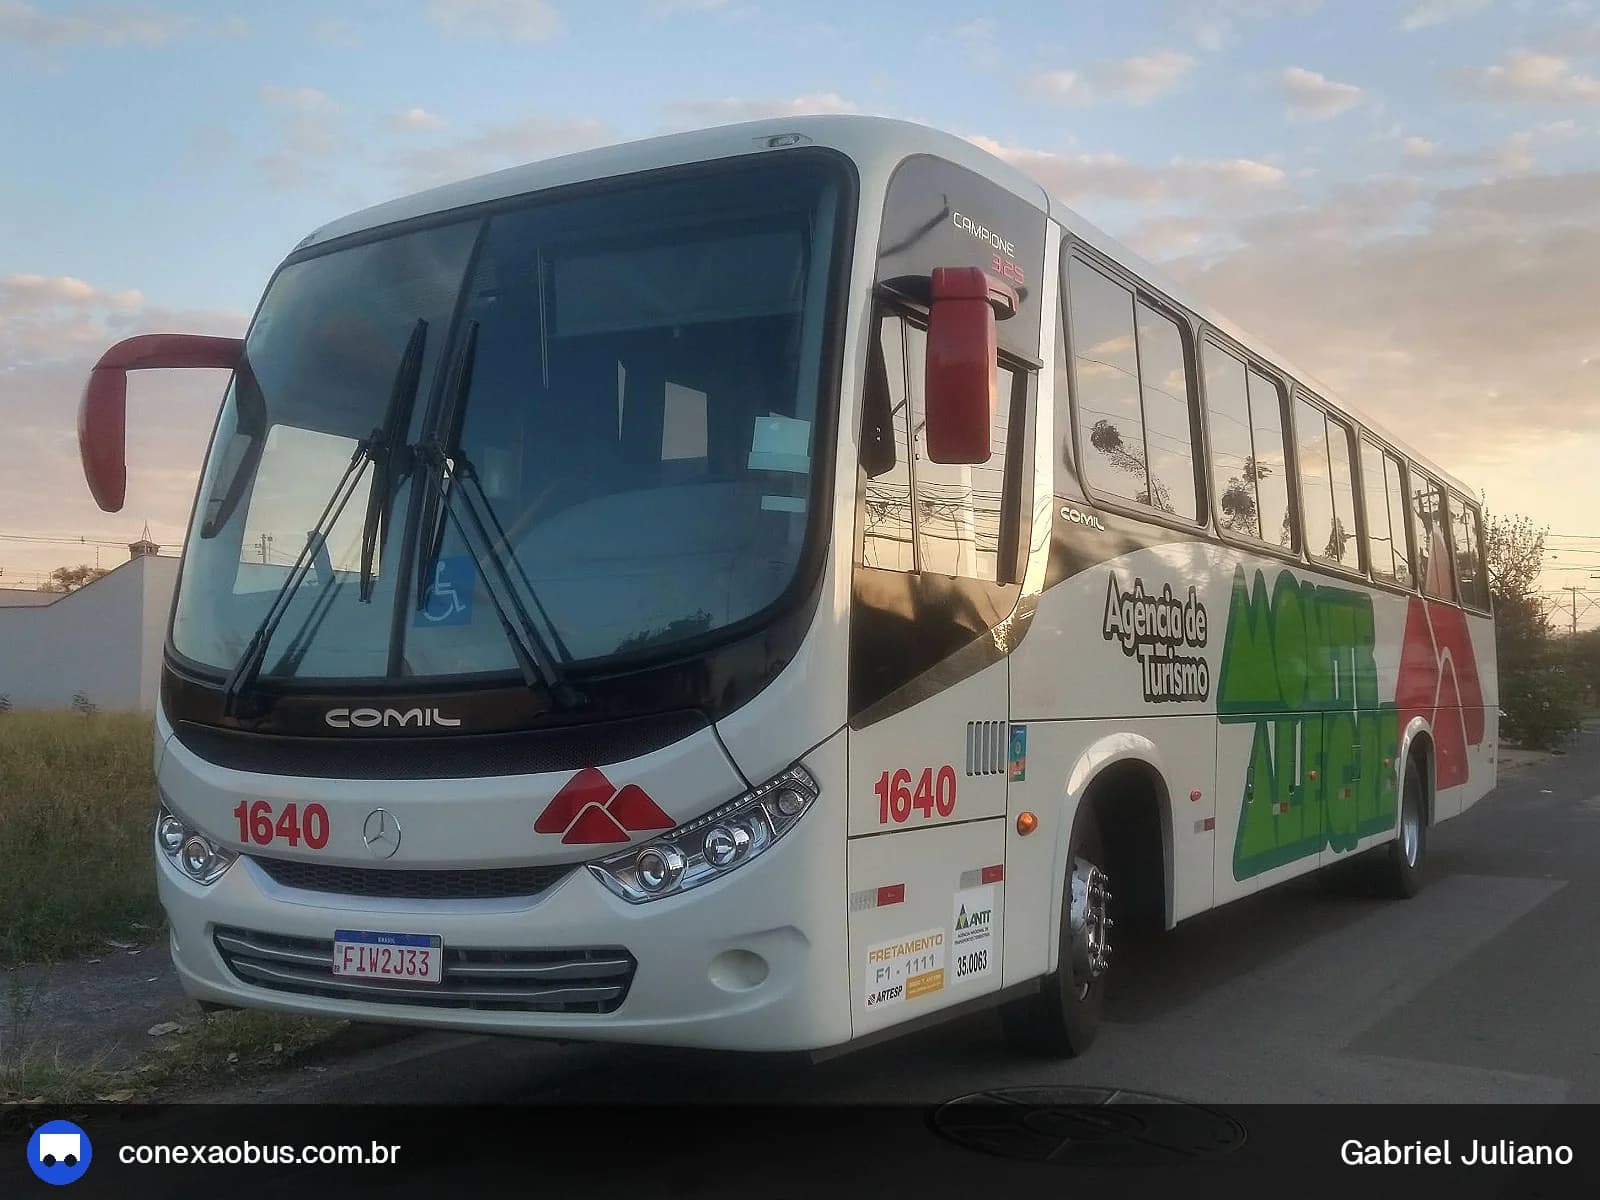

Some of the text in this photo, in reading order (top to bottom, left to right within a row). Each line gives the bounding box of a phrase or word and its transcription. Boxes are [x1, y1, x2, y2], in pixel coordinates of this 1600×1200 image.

[953, 212, 1015, 258] CAMPIONE
[1060, 506, 1105, 532] COMIL
[1102, 569, 1208, 657] Agência de
[1137, 643, 1210, 703] Turismo
[325, 708, 461, 728] COMIL
[874, 765, 957, 824] 1640
[233, 800, 330, 850] 1640
[969, 909, 991, 927] ANTT
[343, 946, 430, 976] FIW2J33
[869, 933, 943, 964] FRETAMENTO
[957, 949, 988, 977] 35.0063
[875, 965, 892, 984] F1
[905, 953, 936, 975] 1111
[875, 985, 903, 1004] ARTESP
